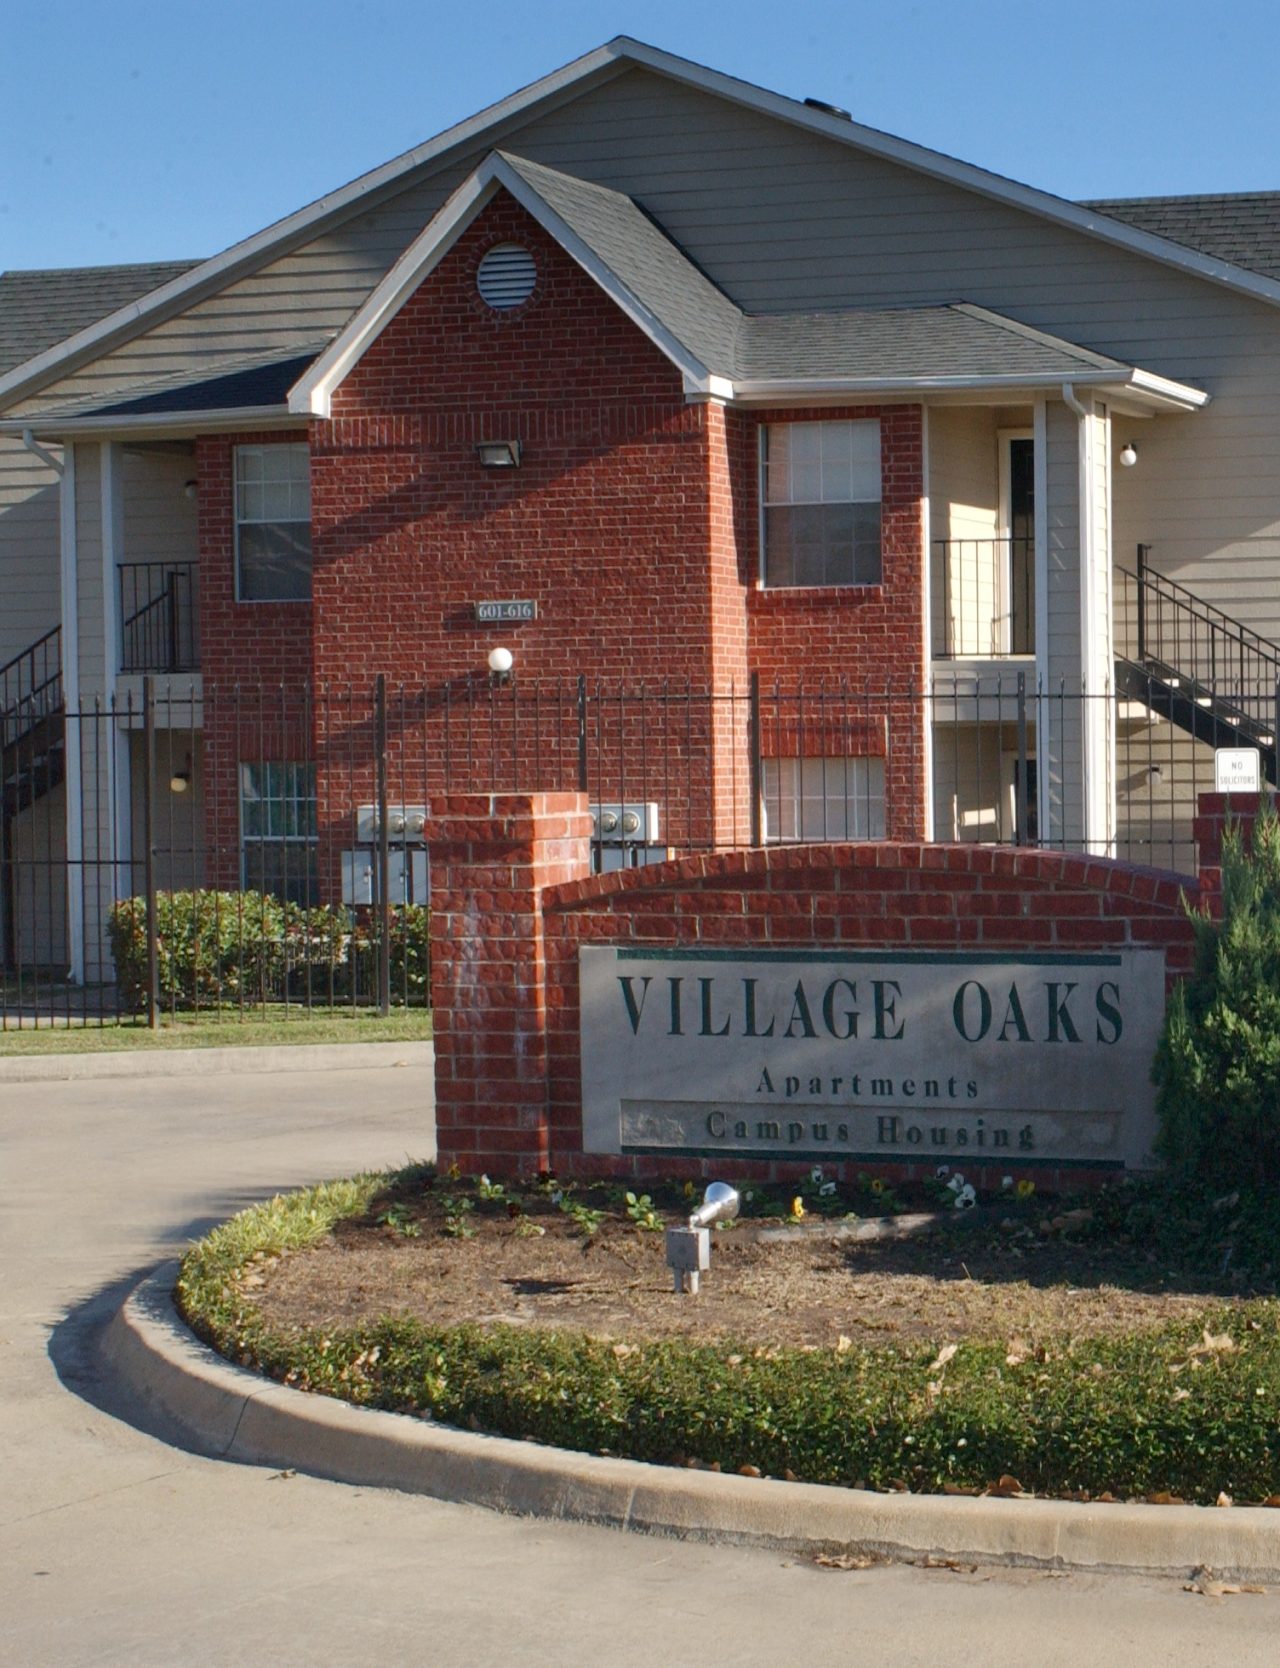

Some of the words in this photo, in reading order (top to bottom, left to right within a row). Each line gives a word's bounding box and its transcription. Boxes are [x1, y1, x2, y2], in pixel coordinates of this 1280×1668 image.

[479, 604, 532, 618] 601-616
[1231, 761, 1243, 770] NO
[1220, 776, 1255, 785] SOLICITORS
[617, 976, 906, 1040] VILLAGE
[952, 980, 1124, 1044] OAKS
[756, 1066, 978, 1098] Apartments
[706, 1111, 849, 1143] Campus
[876, 1116, 1035, 1150] Housing
